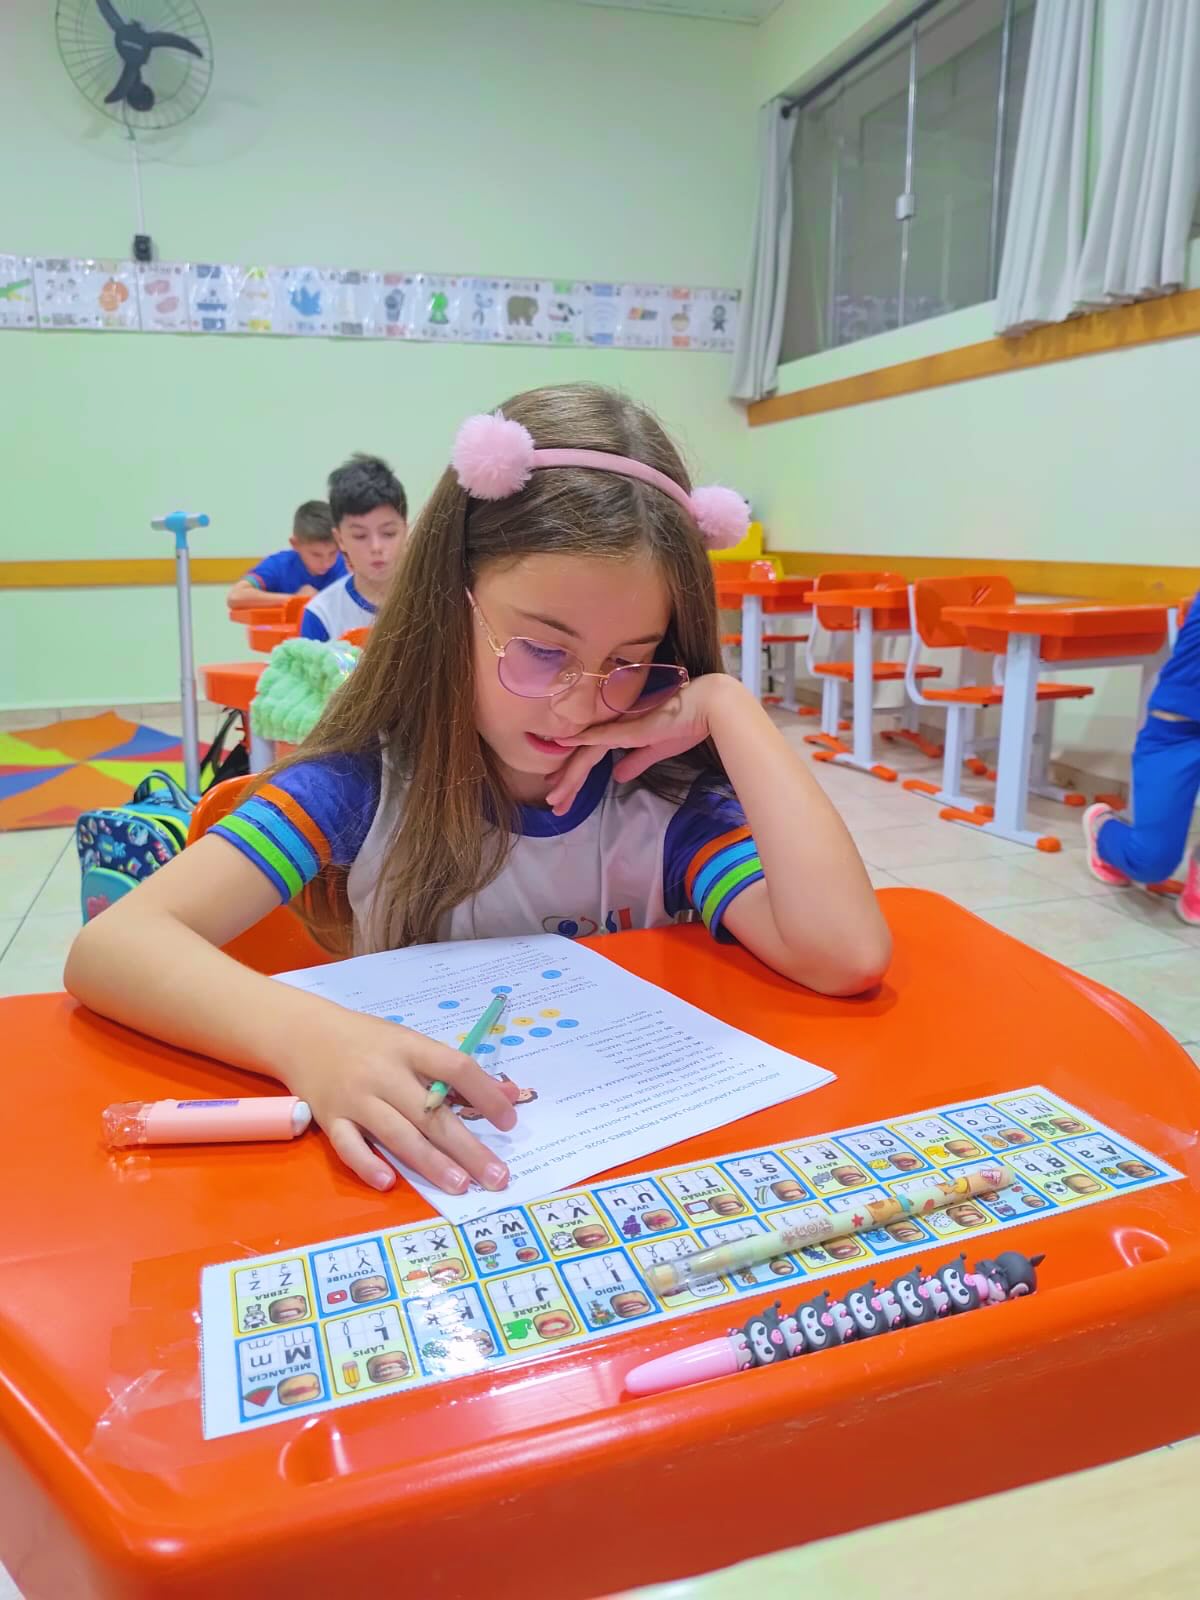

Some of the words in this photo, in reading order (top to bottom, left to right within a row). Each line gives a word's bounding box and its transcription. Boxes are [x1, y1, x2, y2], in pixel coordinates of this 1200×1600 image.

[1014, 1107, 1028, 1115] n
[1033, 1101, 1052, 1113] N
[984, 1112, 1001, 1123] O
[936, 1126, 948, 1135] P
[878, 1138, 893, 1146] Q
[928, 1135, 949, 1143] PATO
[1078, 1149, 1094, 1158] a
[1099, 1142, 1117, 1155] A
[802, 1155, 811, 1164] r
[823, 1150, 838, 1160] R
[815, 1161, 837, 1169] RATO
[1024, 1162, 1042, 1172] b
[1045, 1156, 1065, 1168] B
[738, 1168, 753, 1177] s
[761, 1163, 777, 1173] S
[1043, 1168, 1066, 1177] BOLA
[703, 1178, 717, 1188] T
[753, 1174, 779, 1183] SKATE
[679, 1184, 690, 1193] t
[680, 1186, 725, 1200] TELEVISÃO
[612, 1197, 627, 1206] u
[637, 1192, 654, 1203] U
[572, 1206, 588, 1218] V
[628, 1204, 649, 1212] UVA
[547, 1212, 559, 1221] v
[501, 1220, 523, 1234] W
[557, 1219, 583, 1228] VACA
[474, 1227, 492, 1238] w
[503, 1230, 528, 1239] WORD
[403, 1244, 417, 1254] x
[430, 1237, 448, 1250] X
[357, 1256, 371, 1268] Y
[409, 1251, 447, 1264] XÍCARA
[328, 1263, 338, 1273] y
[278, 1272, 292, 1286] Z
[327, 1267, 375, 1283] YOUTUBE
[610, 1269, 621, 1282] I
[248, 1279, 260, 1290] z
[582, 1276, 591, 1289] i
[254, 1287, 288, 1300] ZEBRA
[534, 1286, 548, 1301] J
[594, 1284, 625, 1296] ÍNDIO
[507, 1294, 515, 1308] j
[513, 1301, 551, 1318] JACARÉ
[374, 1326, 389, 1340] L
[284, 1345, 311, 1364] M
[352, 1344, 384, 1357] LÁPIS
[250, 1353, 272, 1367] m
[248, 1362, 310, 1382] MELANCIA
